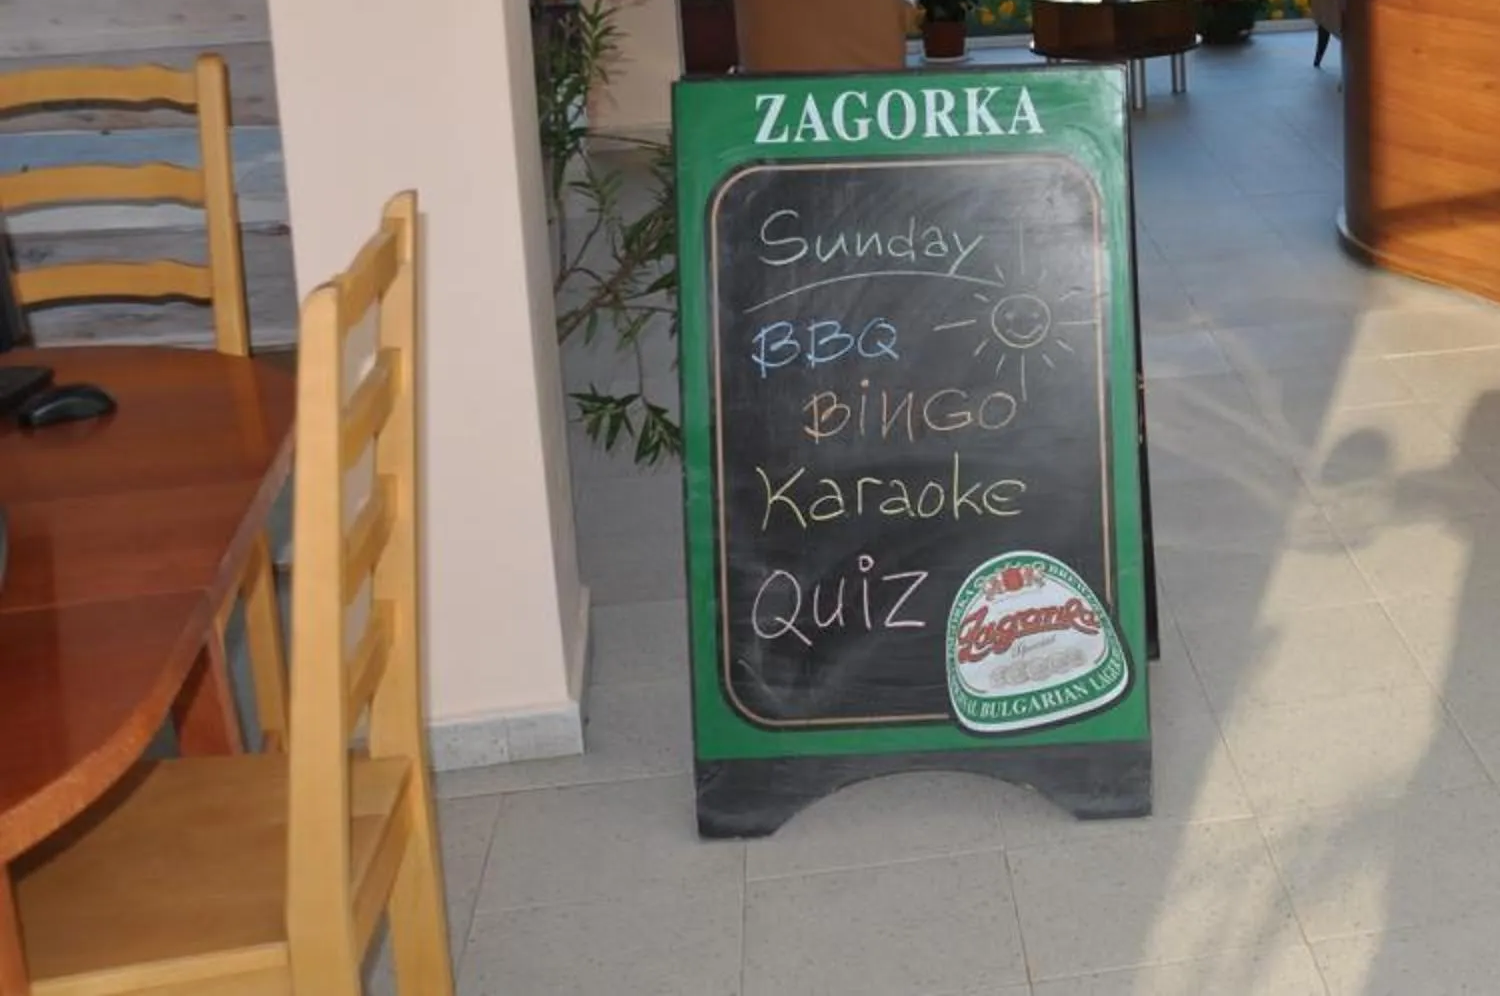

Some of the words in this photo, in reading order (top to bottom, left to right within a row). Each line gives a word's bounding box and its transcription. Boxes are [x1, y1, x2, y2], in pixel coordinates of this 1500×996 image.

[754, 86, 1045, 144] ZAGORKA
[758, 209, 984, 276] Sunday
[751, 317, 899, 378] BBQ
[755, 451, 1028, 531] Karaoke
[979, 680, 1089, 718] BULGARIAN
